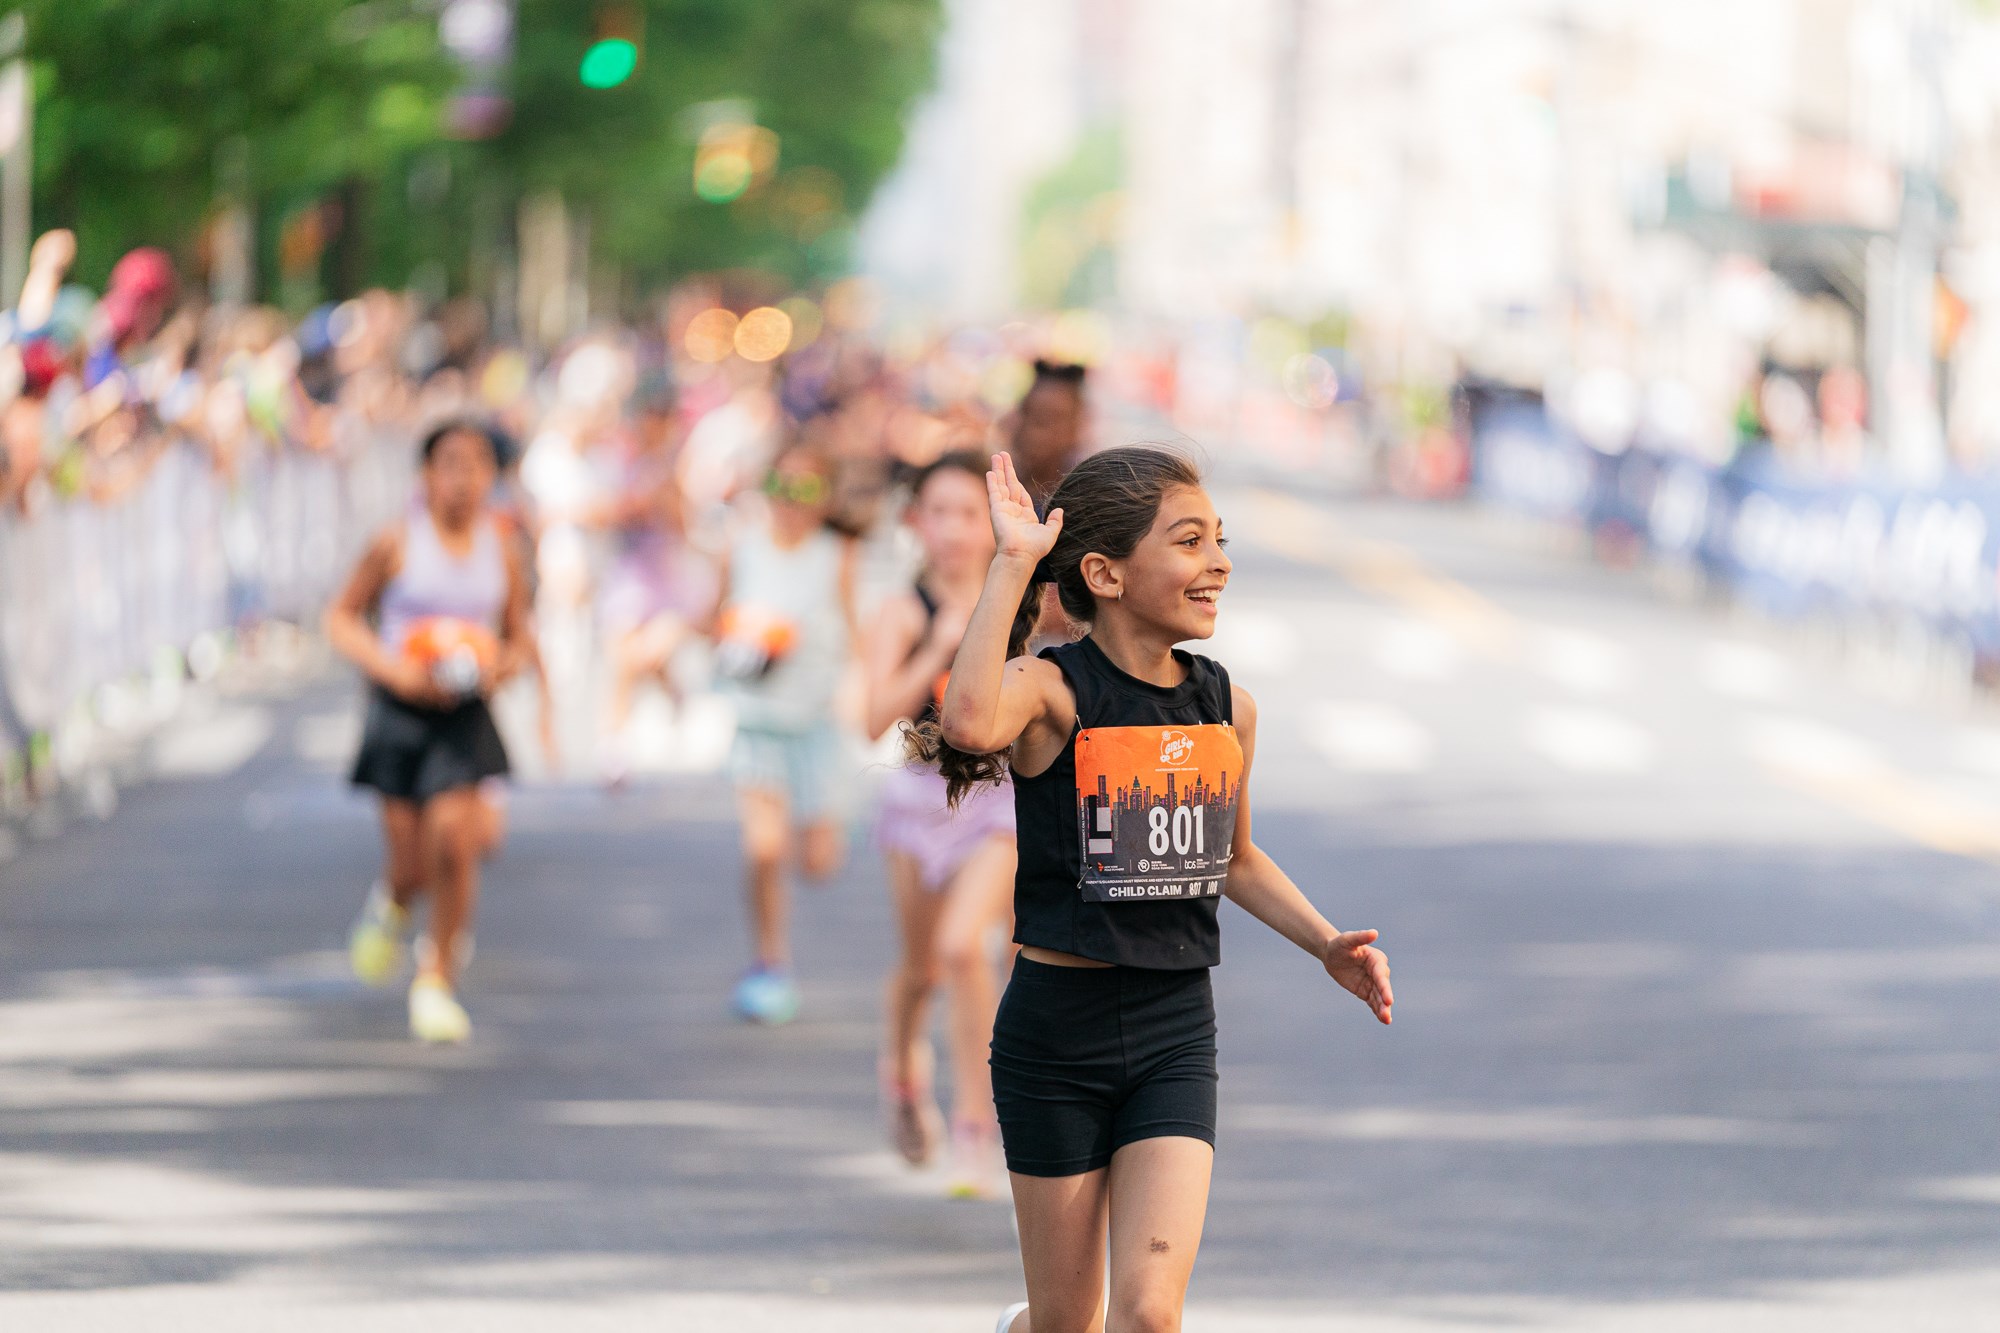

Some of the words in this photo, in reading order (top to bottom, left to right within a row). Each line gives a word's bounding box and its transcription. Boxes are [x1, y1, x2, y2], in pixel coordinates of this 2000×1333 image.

[1165, 737, 1187, 755] GIRLS
[1148, 805, 1204, 856] 801
[1108, 886, 1145, 897] CHILD
[1146, 885, 1182, 896] CLAIM
